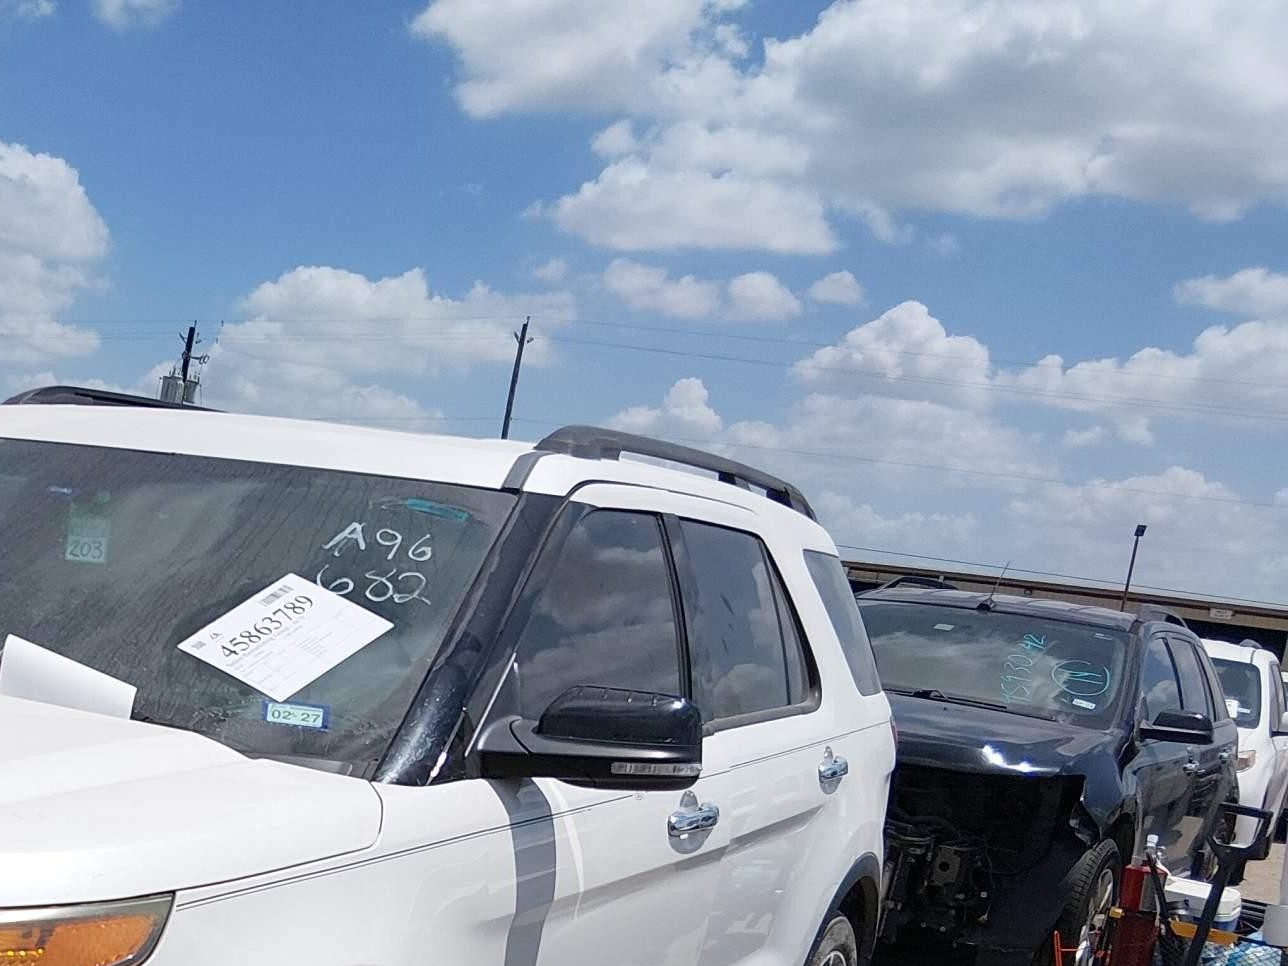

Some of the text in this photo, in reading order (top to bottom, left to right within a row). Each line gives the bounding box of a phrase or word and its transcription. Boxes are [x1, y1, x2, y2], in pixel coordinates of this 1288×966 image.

[321, 521, 432, 562] A96
[316, 563, 431, 605] 682
[221, 594, 315, 659] 45863789
